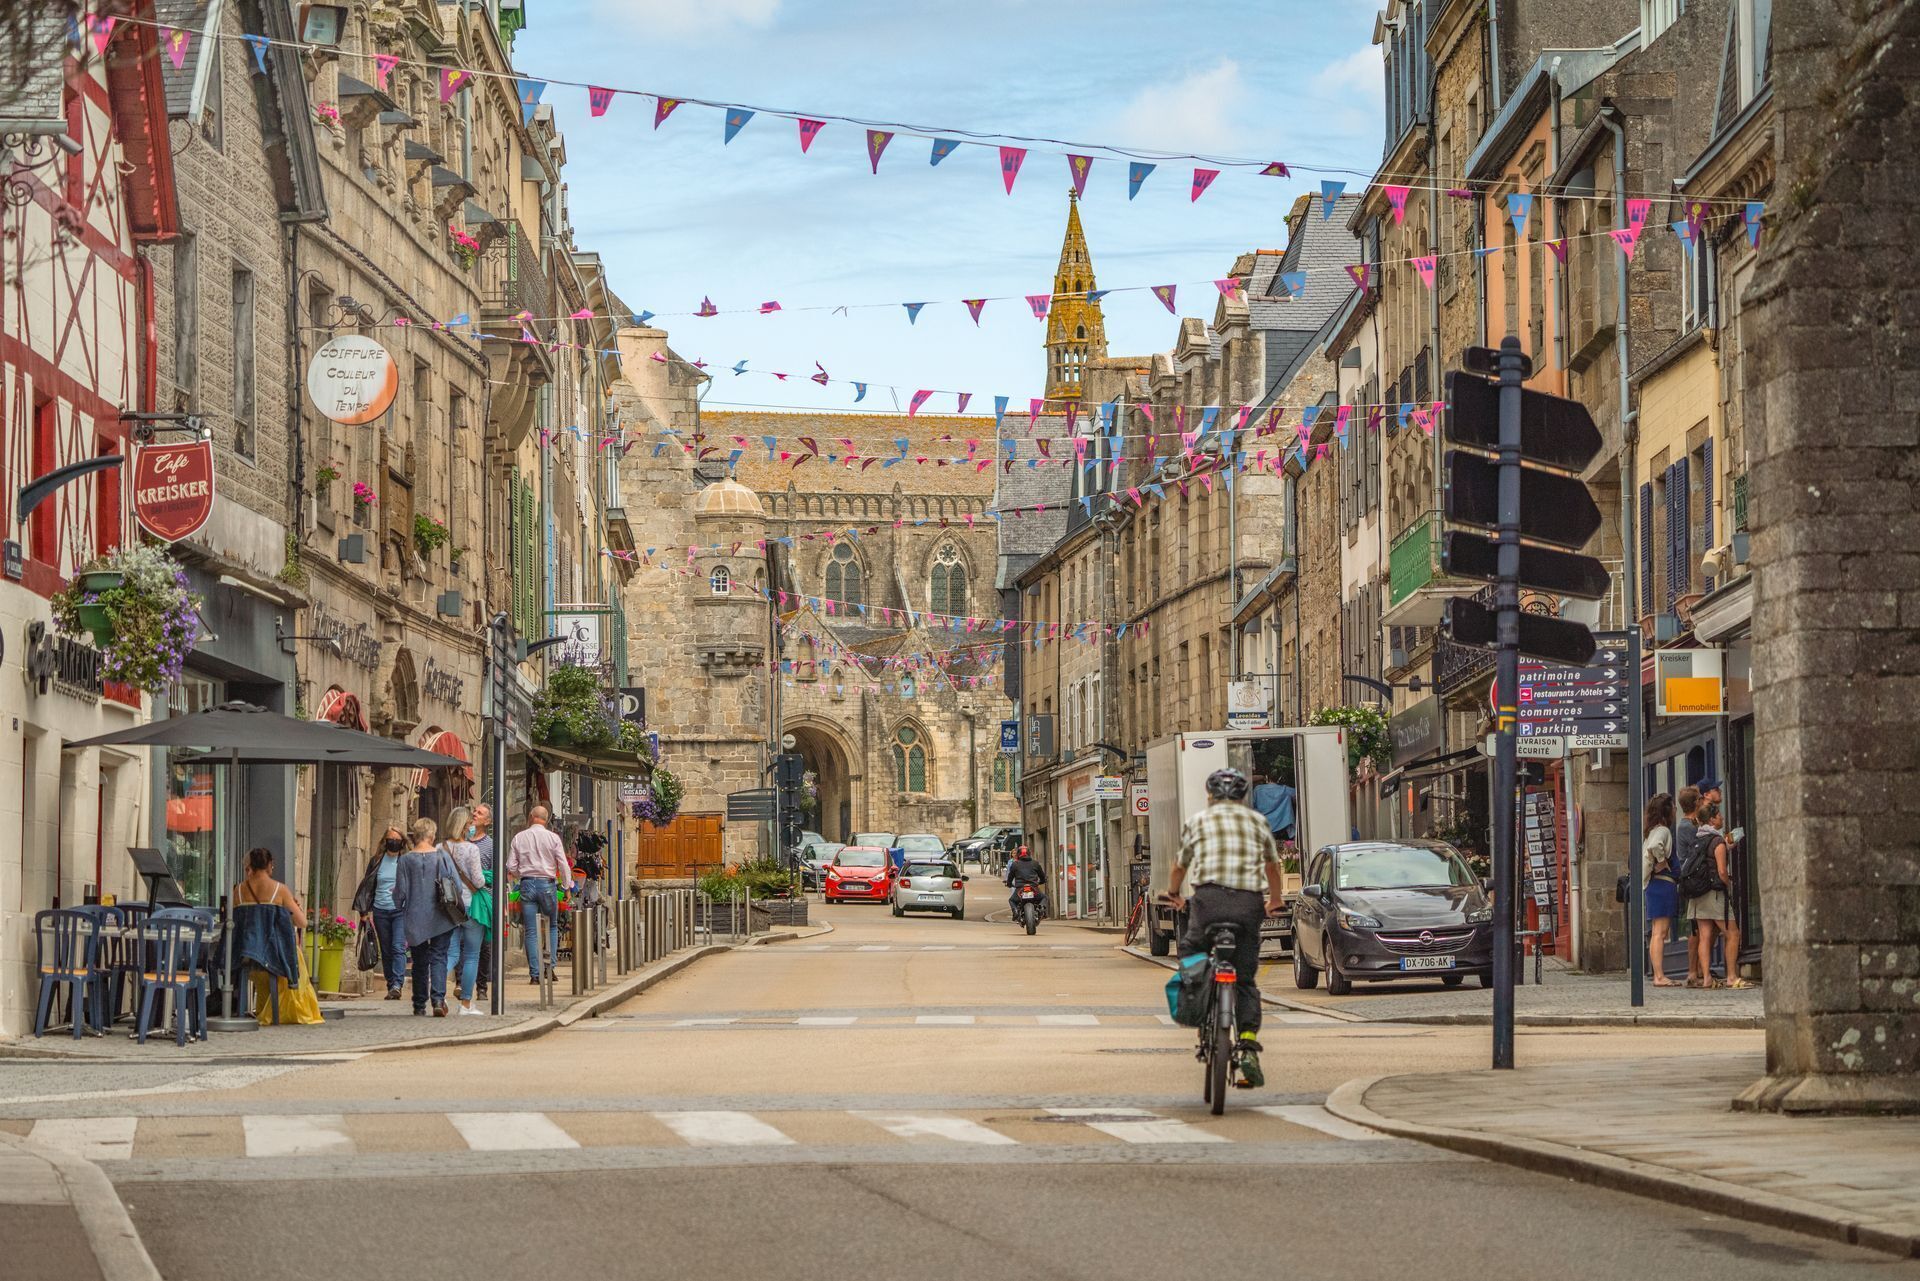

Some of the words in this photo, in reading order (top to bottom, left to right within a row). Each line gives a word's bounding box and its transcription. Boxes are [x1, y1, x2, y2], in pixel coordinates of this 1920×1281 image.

[320, 348, 384, 359] COIFFURE
[343, 386, 357, 395] DU
[336, 400, 369, 412] TEMPS
[154, 453, 189, 474] Café
[167, 474, 177, 483] DU
[137, 480, 209, 505] KREISKER
[1520, 671, 1581, 683] patrimoine
[1534, 688, 1603, 698] restaurants/hôtels
[1520, 707, 1582, 716] commerces
[1679, 703, 1719, 711] Immobilier
[1535, 724, 1578, 735] parking
[1517, 738, 1557, 746] LIVRAISON
[1517, 747, 1550, 755] ÉCURITÉ
[1406, 956, 1448, 968] DX-706-AK
